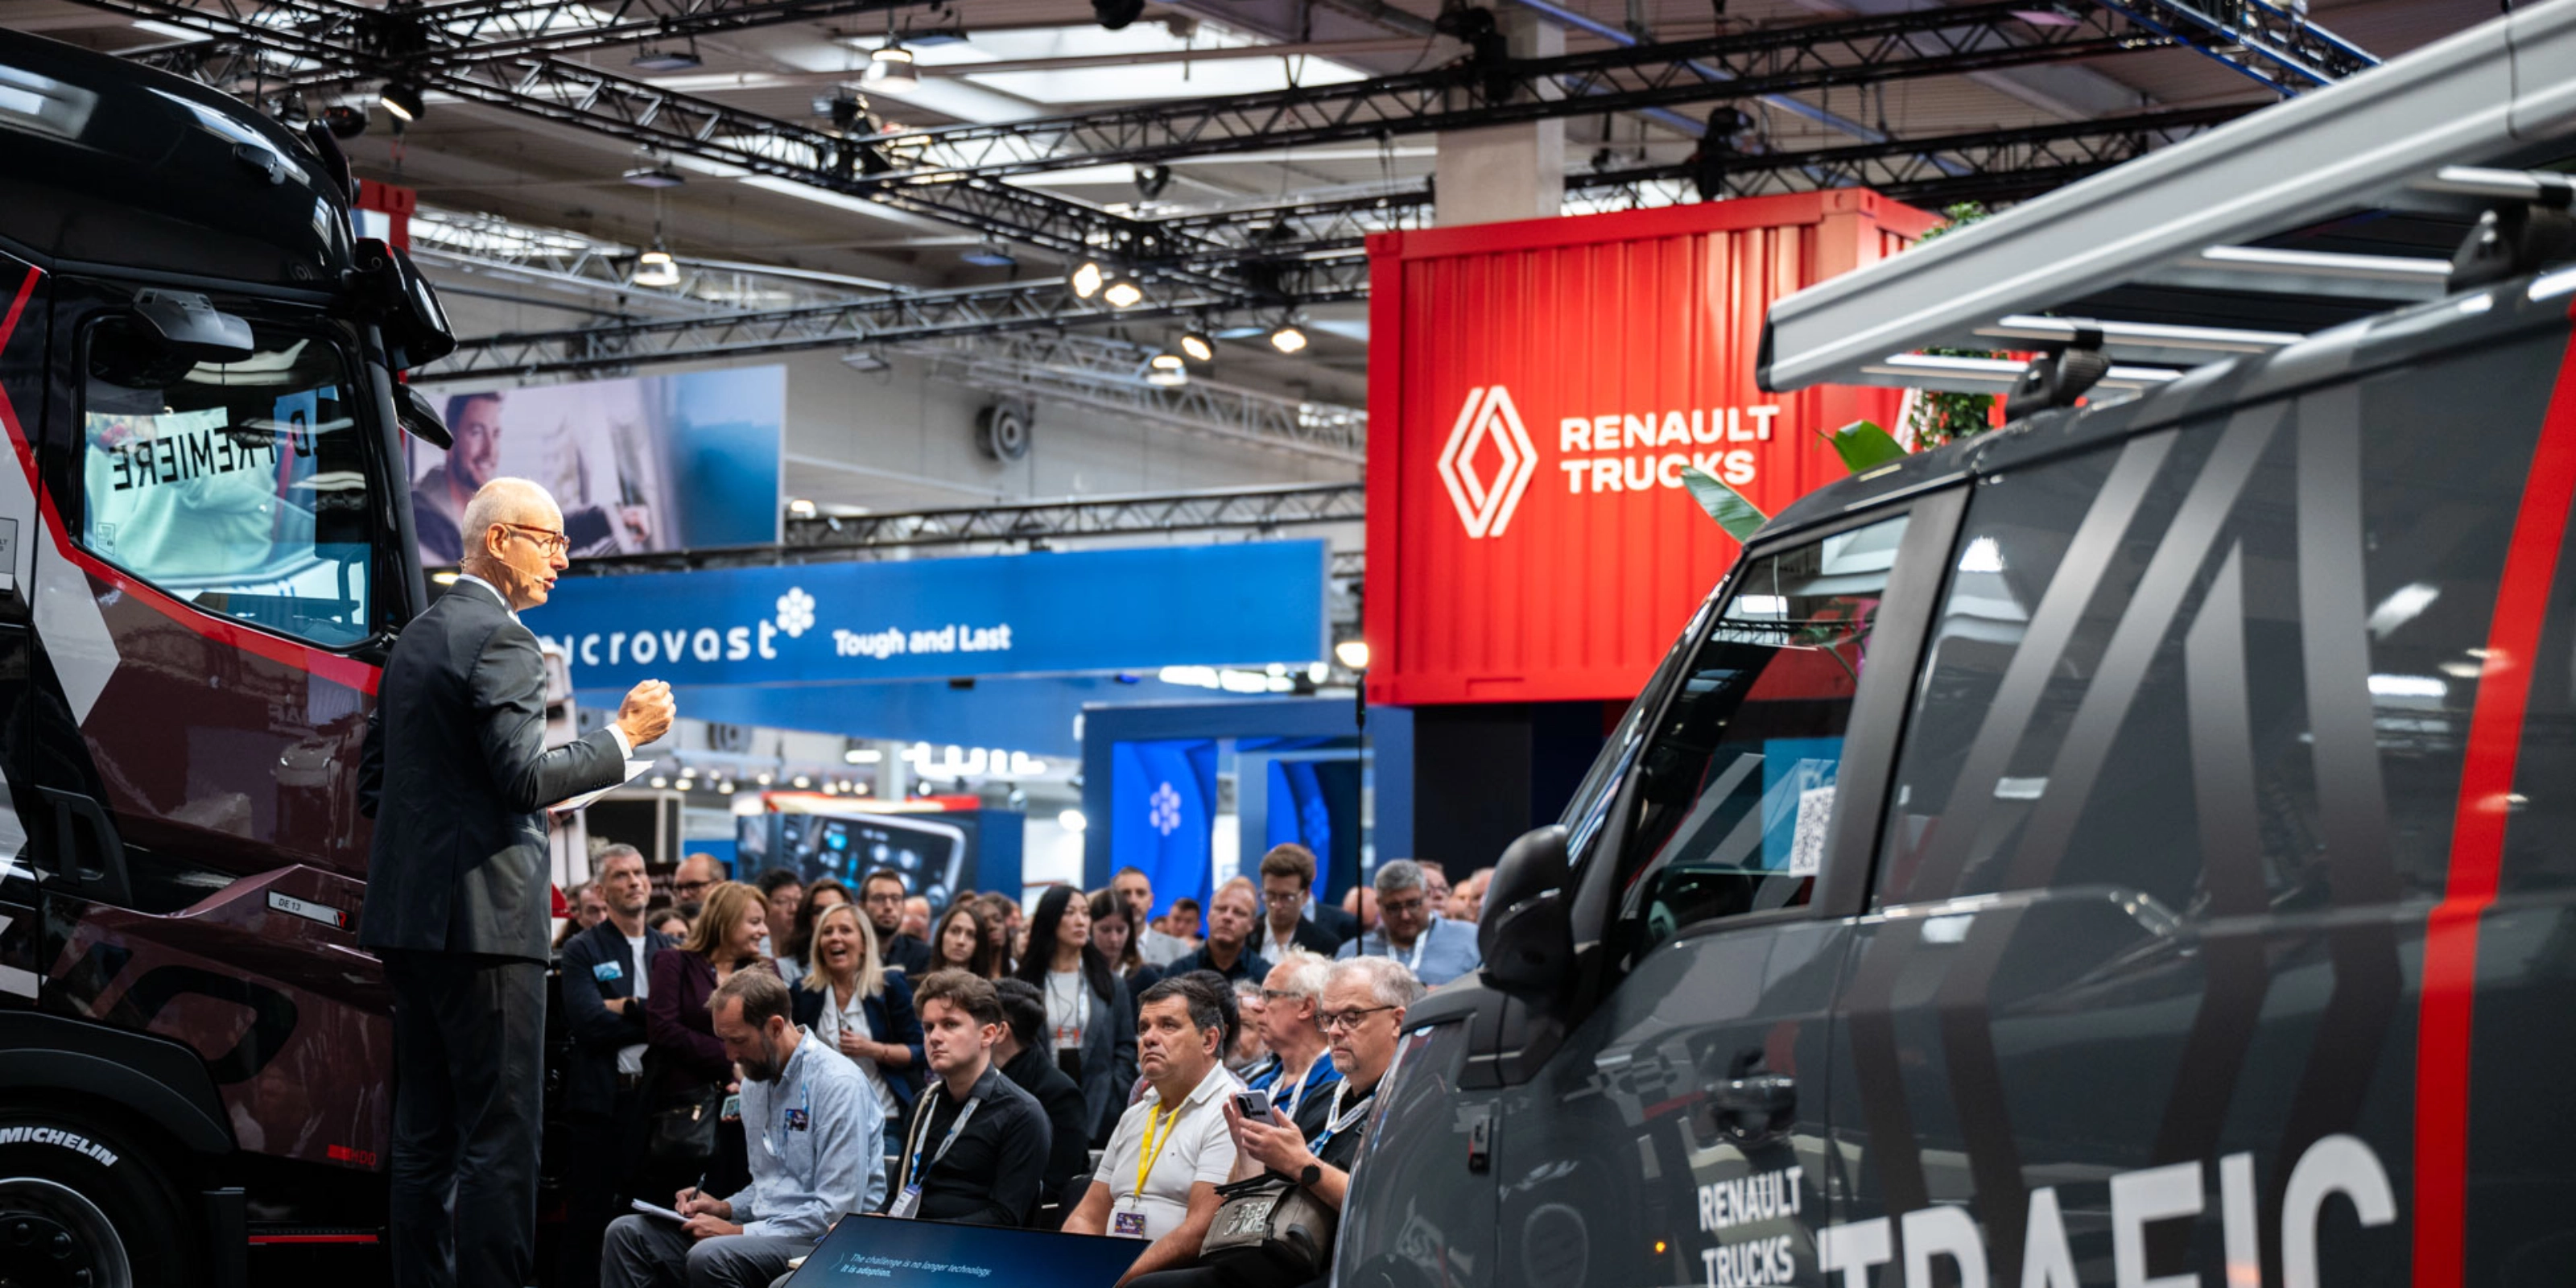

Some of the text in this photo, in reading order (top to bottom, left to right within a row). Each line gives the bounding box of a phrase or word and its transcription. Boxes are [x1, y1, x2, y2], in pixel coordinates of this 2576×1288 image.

[1560, 405, 1780, 452] RENAULT
[1560, 449, 1756, 493] TRUCKS
[538, 618, 778, 667] icrovast
[832, 622, 1012, 659] Tough and Last
[279, 898, 301, 912] DE 13
[0, 1127, 118, 1167] MICHELIN
[1698, 1166, 1803, 1232] RENAULT
[850, 1253, 865, 1263] The
[865, 1256, 903, 1268] challenge
[902, 1259, 911, 1268] is
[922, 1261, 949, 1273] longer
[1700, 1234, 1795, 1288] TRUCKS
